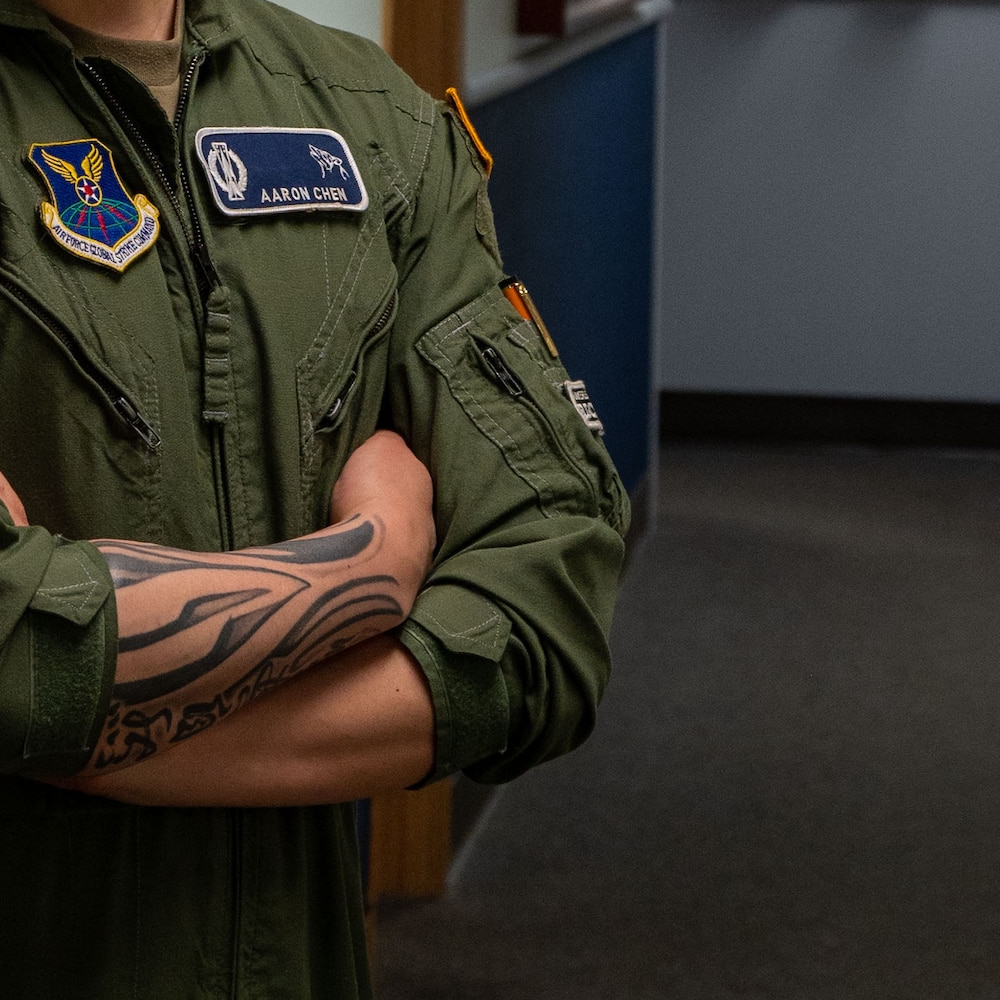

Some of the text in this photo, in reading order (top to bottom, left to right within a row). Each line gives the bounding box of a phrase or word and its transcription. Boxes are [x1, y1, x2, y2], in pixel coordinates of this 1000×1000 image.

[260, 186, 348, 203] AARON CHEN
[52, 216, 156, 264] AIR FORCE GLOBAL STRIKE COMMAND
